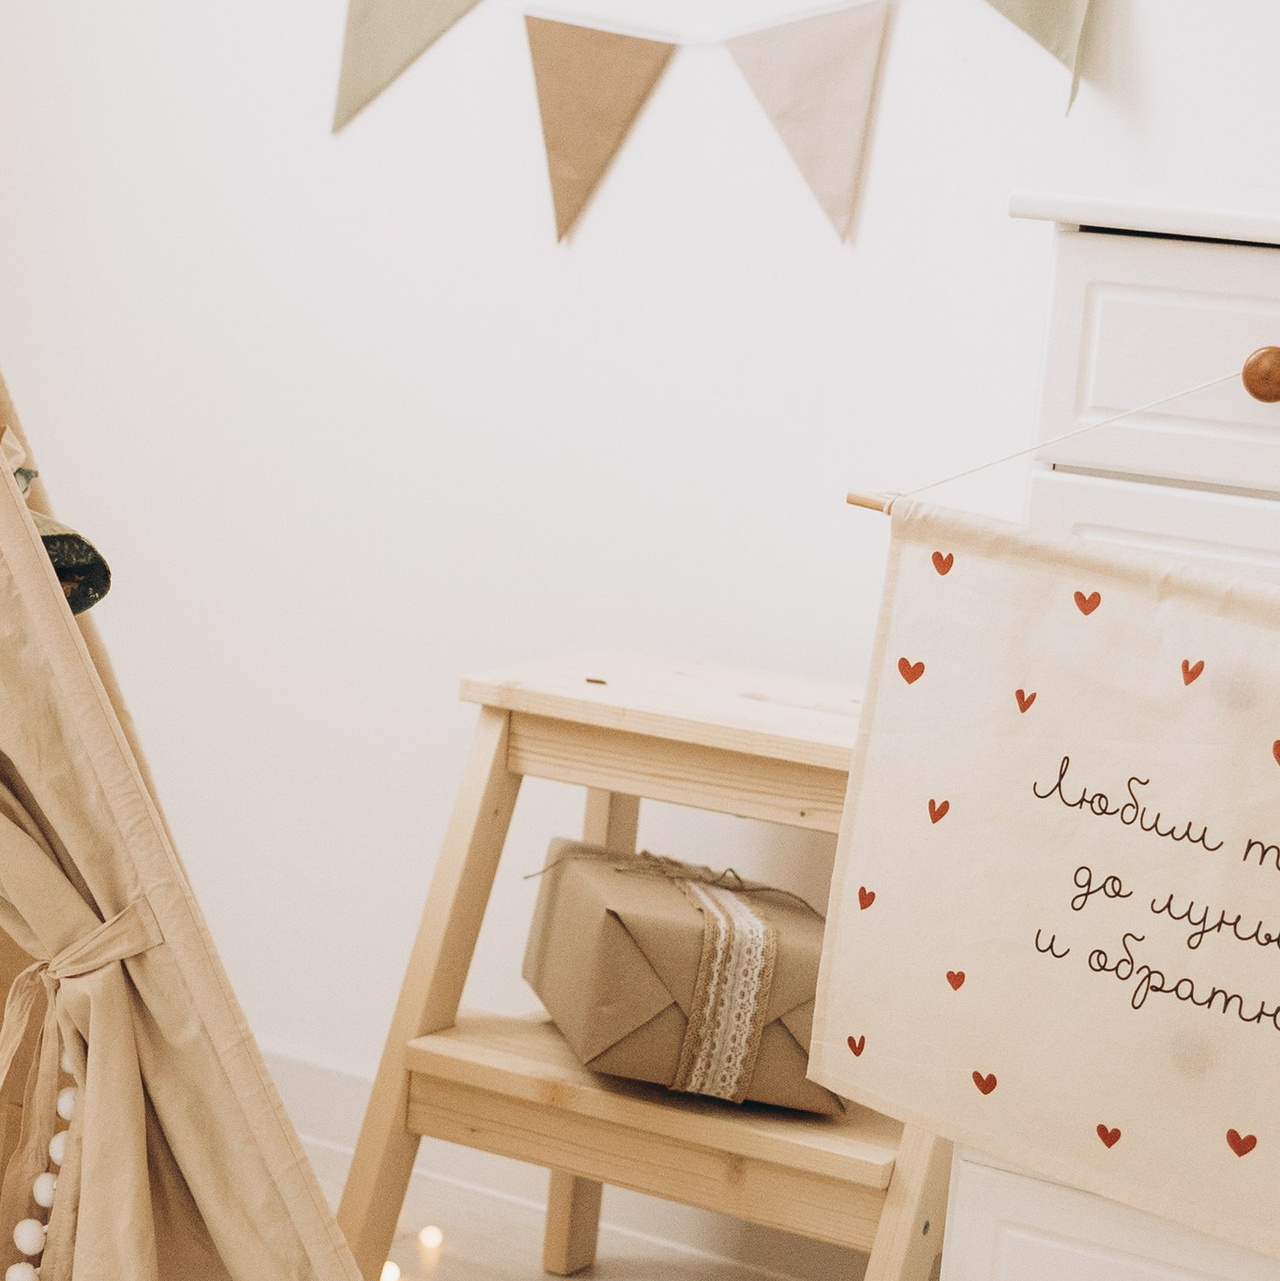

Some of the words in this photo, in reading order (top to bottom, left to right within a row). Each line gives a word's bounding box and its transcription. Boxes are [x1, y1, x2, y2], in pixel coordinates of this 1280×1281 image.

[1032, 755, 1224, 852] Любим
[1070, 866, 1133, 911] до
[1035, 928, 1070, 959] и
